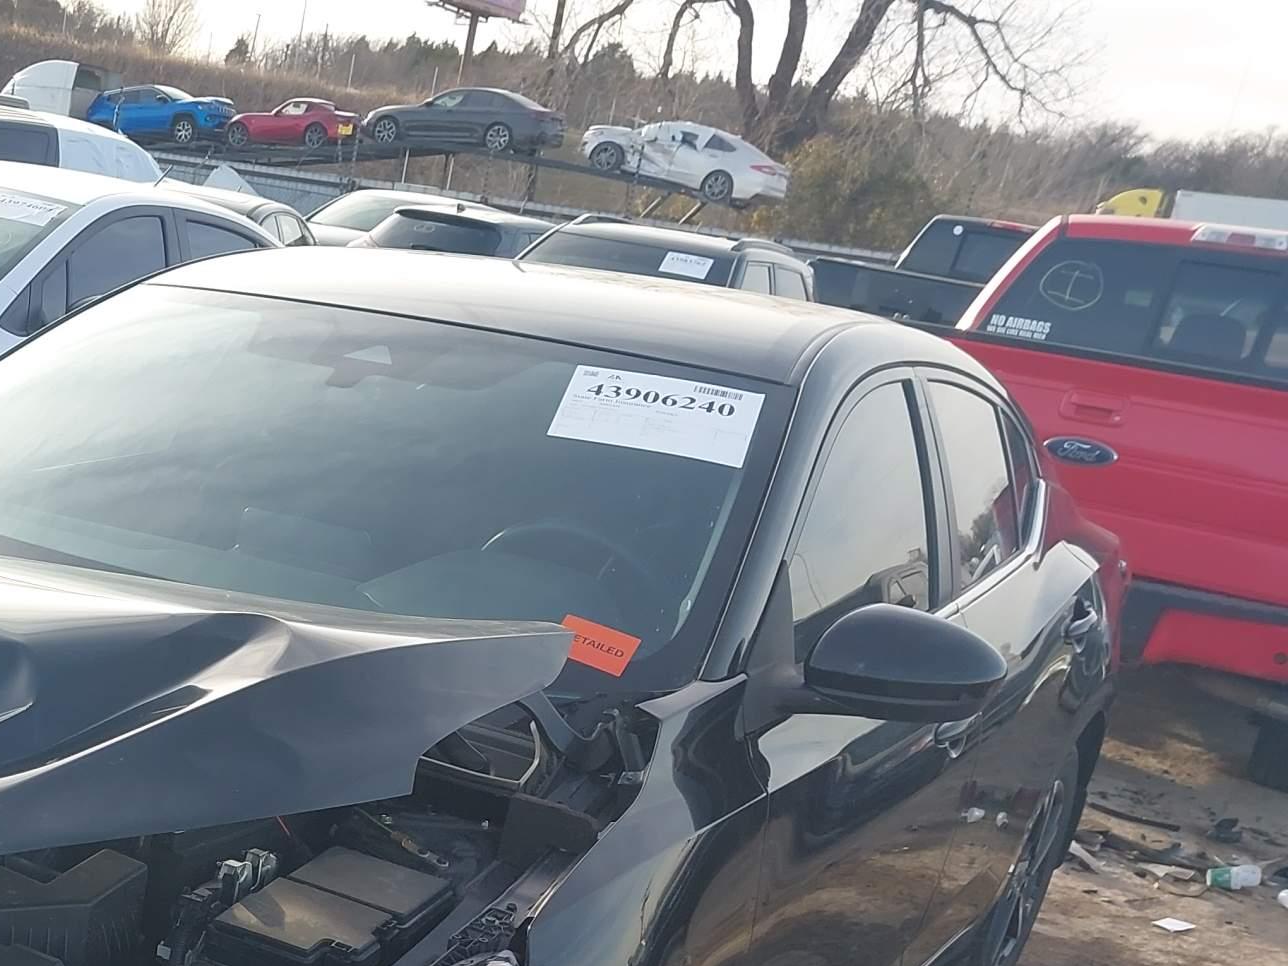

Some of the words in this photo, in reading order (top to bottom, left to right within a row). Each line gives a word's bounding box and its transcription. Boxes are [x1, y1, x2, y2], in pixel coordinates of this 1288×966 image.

[990, 314, 1007, 327] NO
[1005, 316, 1052, 334] AIRBAGS
[587, 384, 736, 417] 43906240
[574, 634, 625, 658] ETAILED
